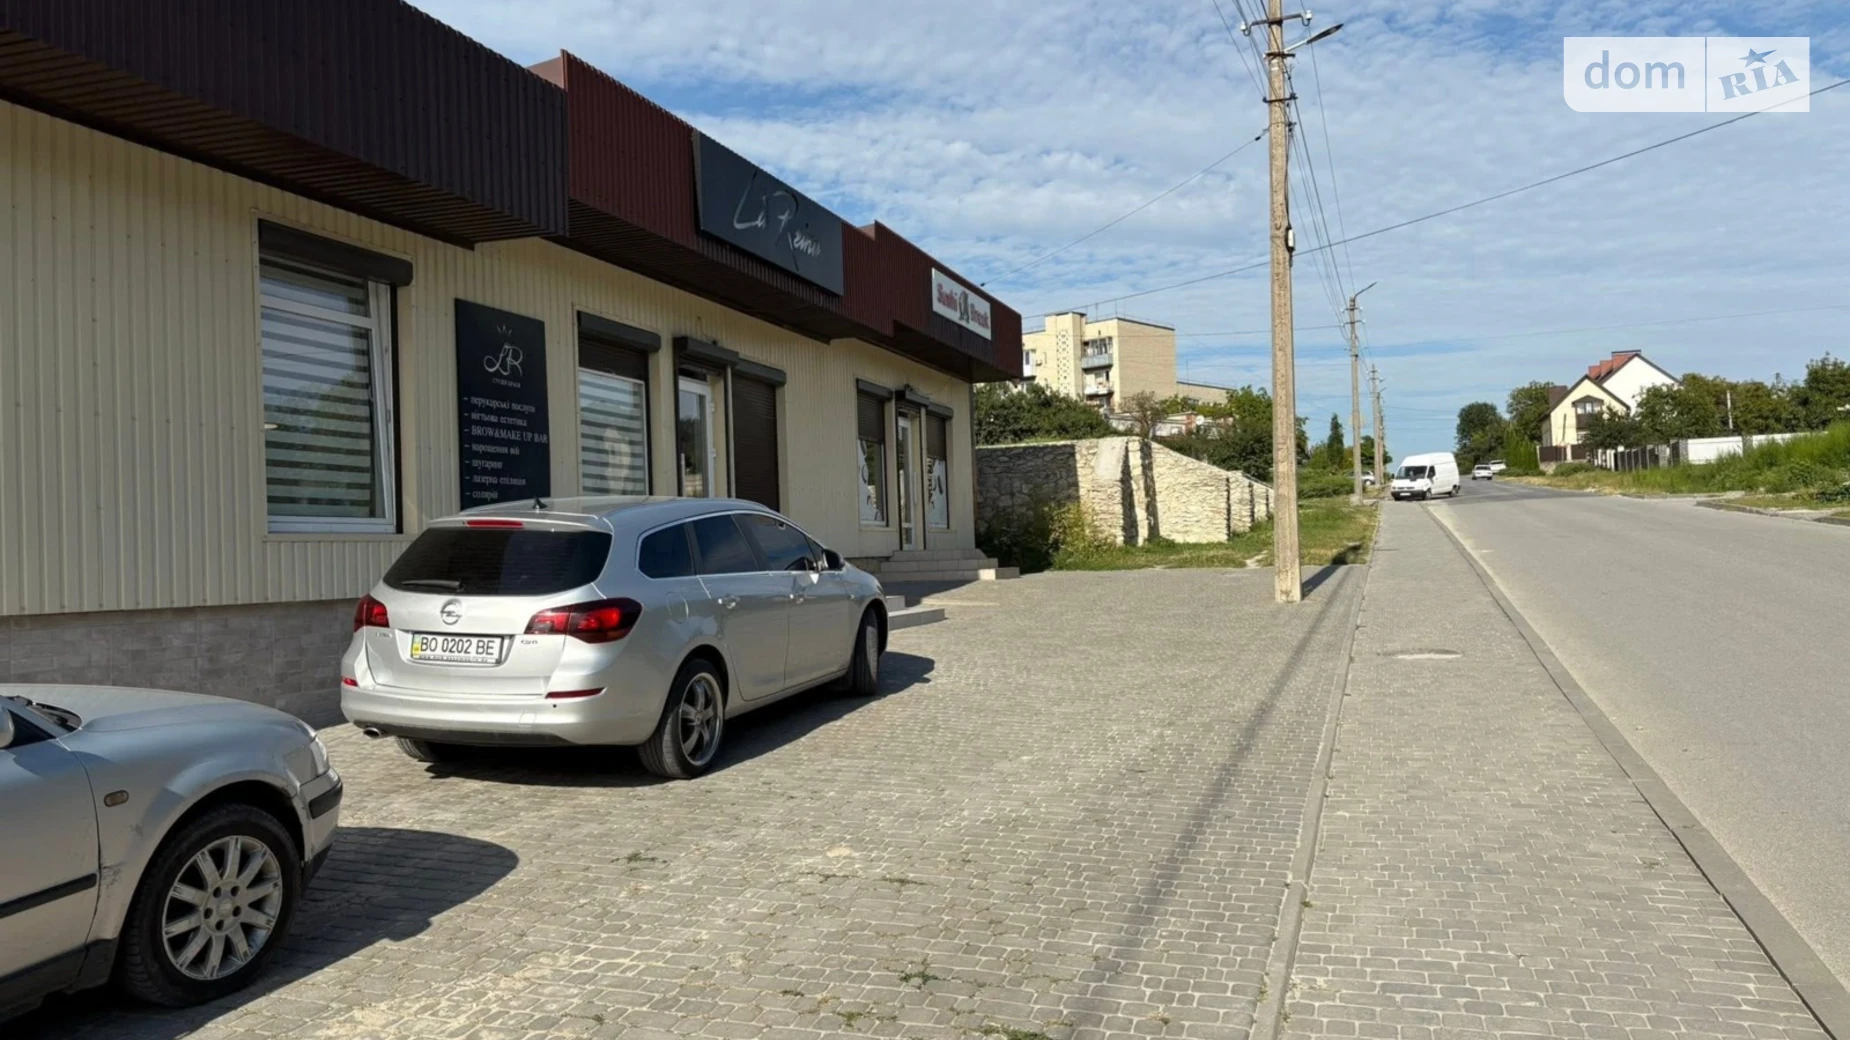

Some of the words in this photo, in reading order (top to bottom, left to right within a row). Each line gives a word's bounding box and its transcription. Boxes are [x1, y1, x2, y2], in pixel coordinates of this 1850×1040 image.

[420, 636, 438, 652] BO
[441, 638, 473, 654] 0202
[475, 640, 496, 656] BE
